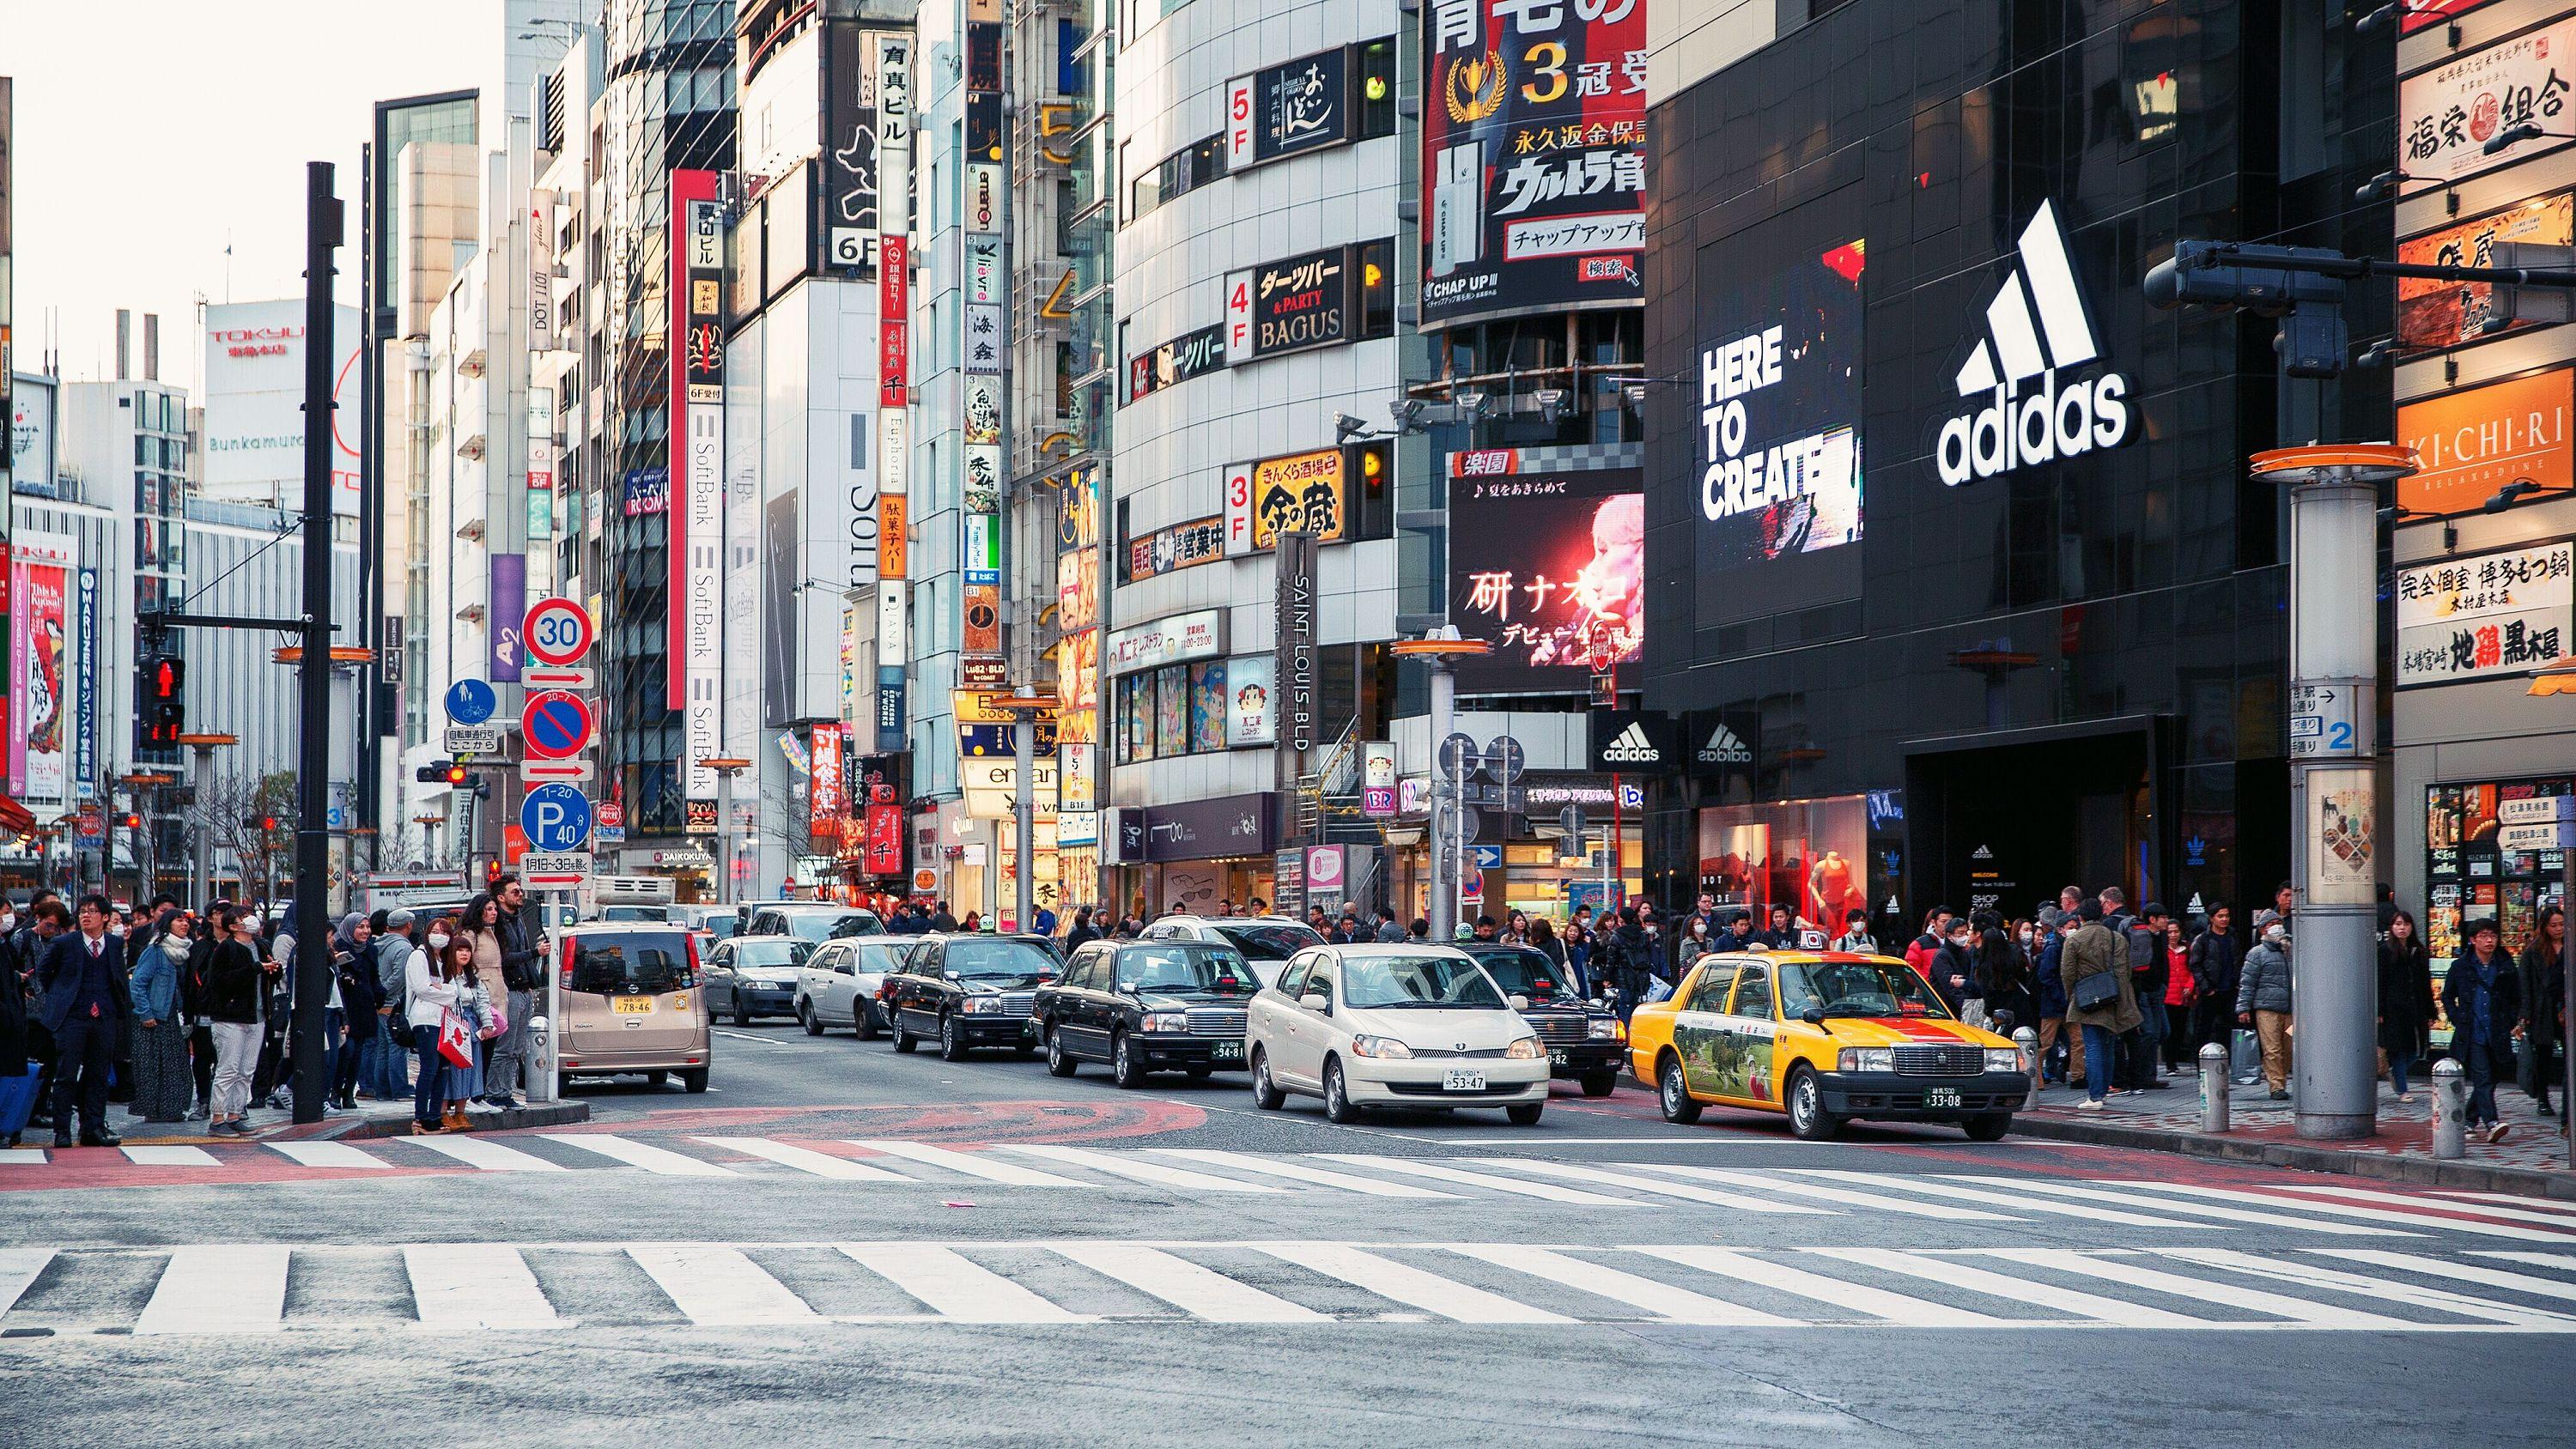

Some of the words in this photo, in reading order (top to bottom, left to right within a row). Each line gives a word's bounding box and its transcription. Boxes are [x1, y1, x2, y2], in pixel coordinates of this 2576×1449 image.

[1233, 88, 1249, 155] 5F
[1260, 258, 1340, 300] ダーツバー
[1587, 258, 1623, 276] 検索
[889, 264, 901, 312] 銀座カラー
[1230, 282, 1249, 348] 4F
[1260, 307, 1340, 350] BAGUS
[1703, 324, 1783, 406] HERE
[1703, 398, 1747, 463] TO
[1937, 367, 2127, 488] adidas
[1463, 452, 1510, 476] 楽園
[1703, 432, 1825, 522] CREATE
[696, 442, 715, 526] SoftBank
[1230, 476, 1249, 541] 3F
[884, 503, 901, 571] 駄菓子バー
[2400, 565, 2471, 603] 完全個室
[2477, 549, 2570, 589] 博多もつ鍋
[694, 573, 714, 659] SoftBank
[1294, 574, 1309, 637] SAINT
[539, 616, 578, 647] 30
[1294, 644, 1310, 703] LOUIS
[545, 692, 571, 704] 20-7
[448, 740, 495, 752] ここから
[1294, 712, 1309, 751] BLD
[2329, 721, 2353, 750] 2
[1602, 747, 1660, 762] adidas
[541, 785, 574, 799] 7-20
[1367, 791, 1393, 809] BR
[326, 807, 342, 825] 3
[537, 801, 566, 845] P
[576, 814, 585, 828] 分
[507, 839, 524, 849] au
[556, 825, 576, 845] 40
[663, 852, 713, 862] DAIKOKUYA
[623, 1003, 650, 1012] 78-46
[1218, 1047, 1243, 1057] 94-81
[1453, 1077, 1484, 1088] 53-47
[1930, 1094, 1960, 1106] 33-08
